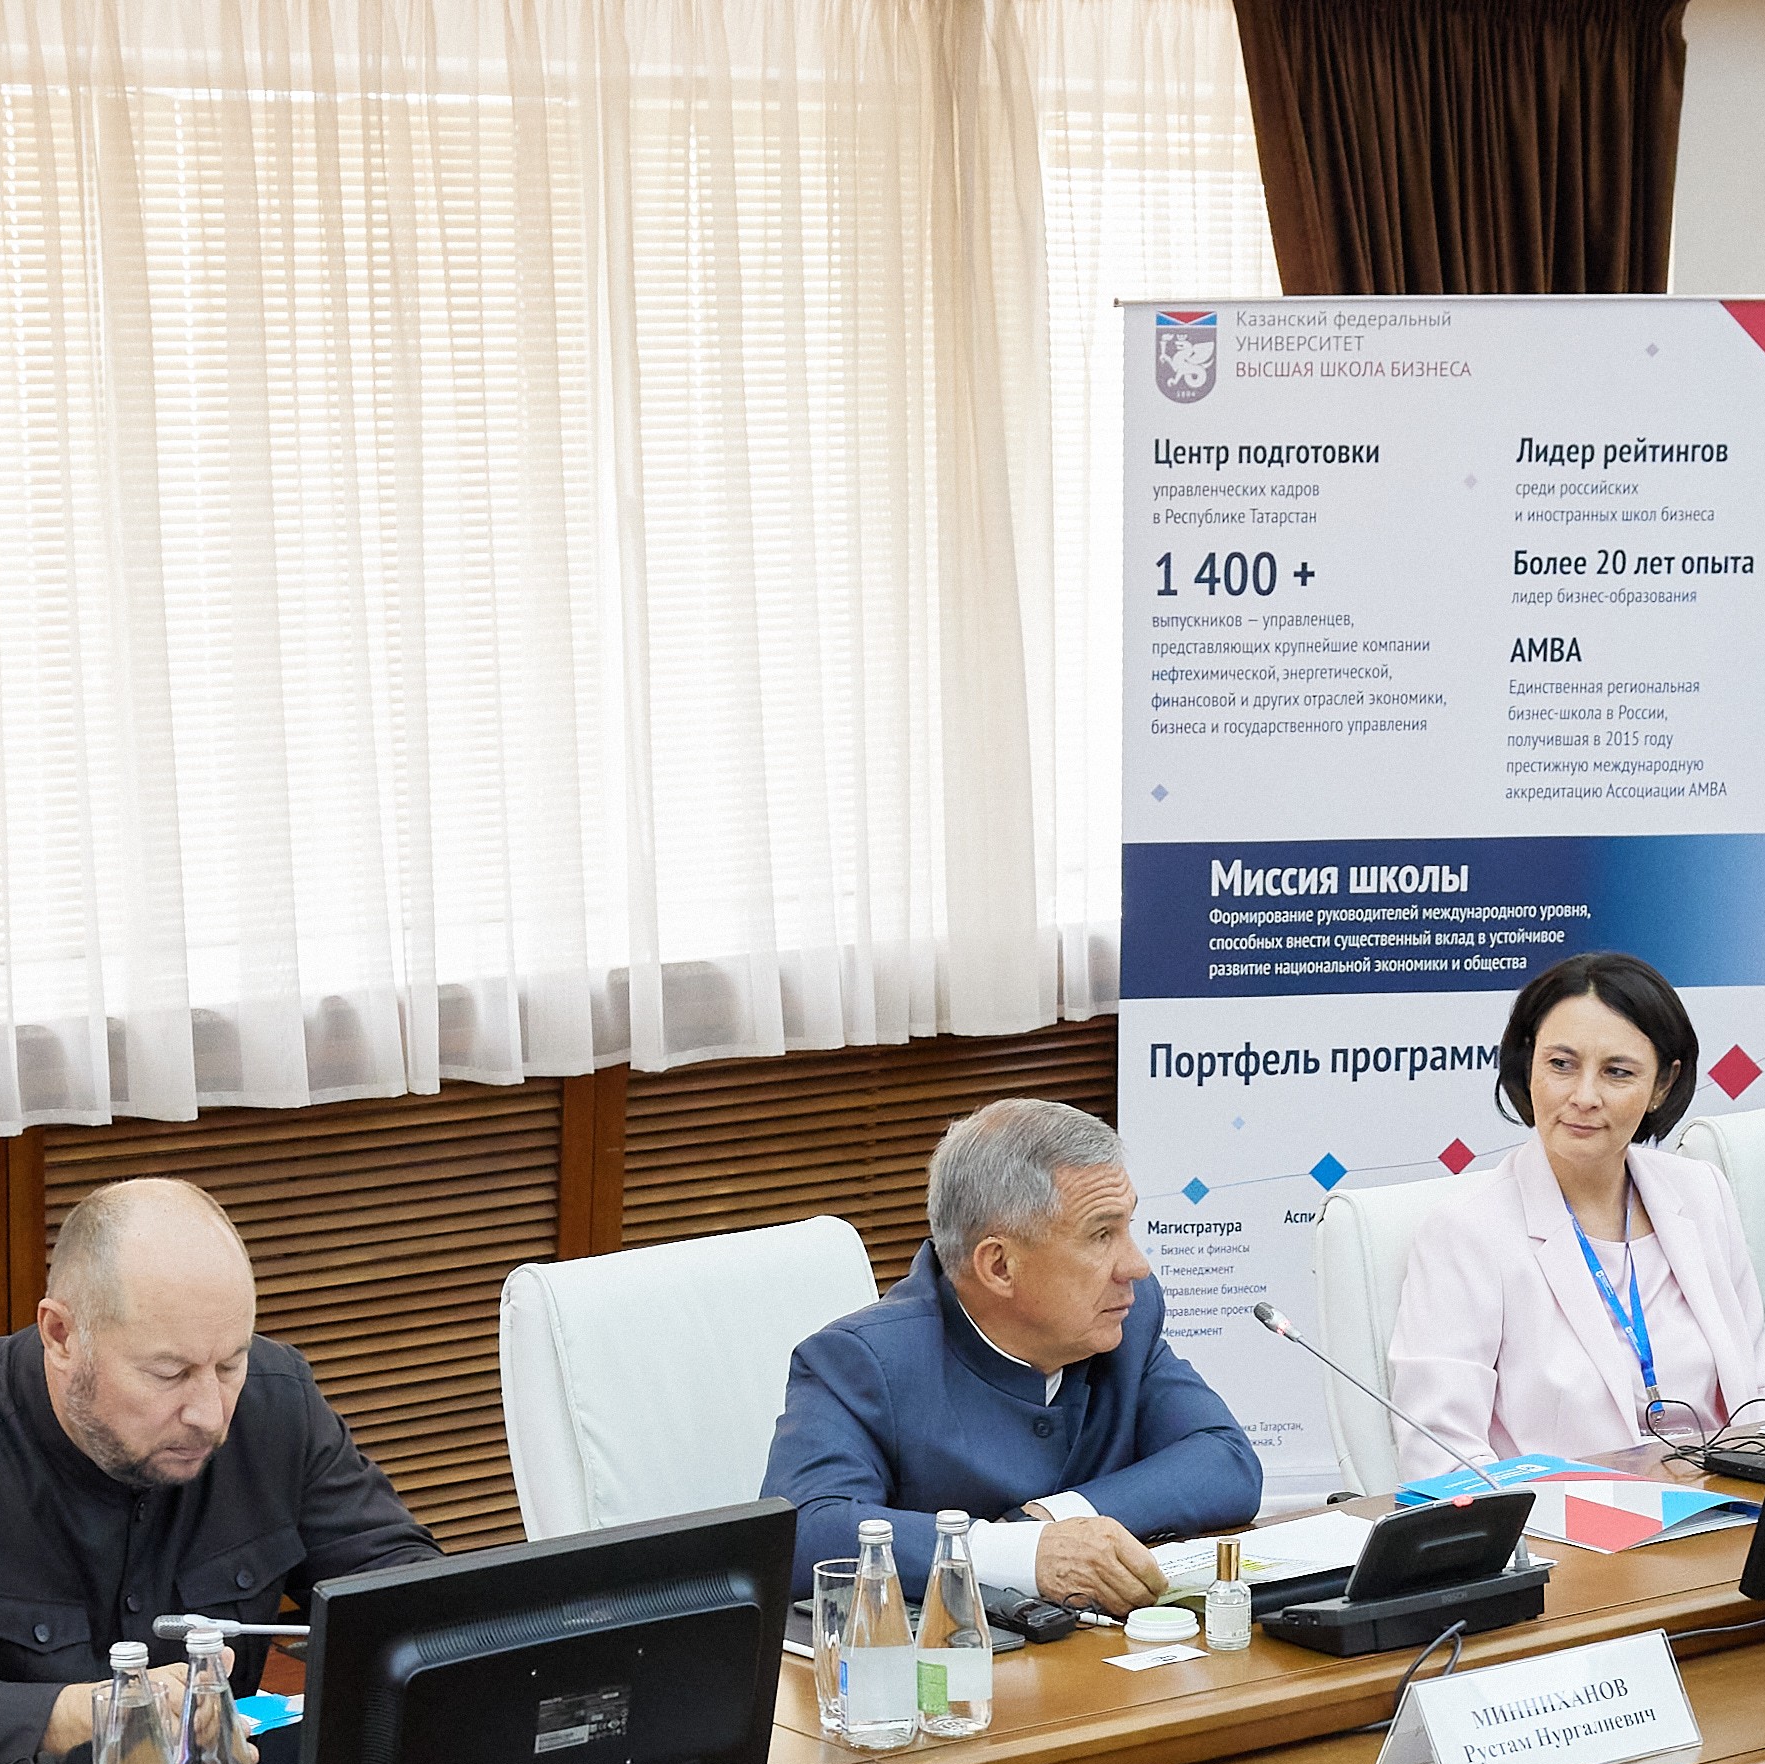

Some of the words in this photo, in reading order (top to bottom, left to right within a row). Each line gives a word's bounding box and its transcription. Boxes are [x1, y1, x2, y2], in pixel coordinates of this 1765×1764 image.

[1235, 310, 1327, 327] Казанский
[1332, 310, 1451, 330] федеральный
[1234, 334, 1364, 352] УНИВЕРСИТЕТ
[1235, 360, 1313, 378] ВЫСШАЯ
[1319, 360, 1386, 378] ШКОЛА
[1390, 360, 1472, 377] БИЗНЕСА
[1153, 437, 1230, 472] Центр
[1237, 443, 1379, 468] подготовки
[1515, 436, 1595, 470] Лидер
[1602, 436, 1728, 470] рейтингов
[1151, 483, 1266, 502] управленческих
[1269, 483, 1320, 500] кадров
[1514, 482, 1555, 499] среди
[1559, 479, 1639, 499] российских
[1164, 507, 1246, 528] Республике
[1248, 507, 1317, 528] Татарстан
[1526, 509, 1618, 526] иностранных
[1620, 509, 1657, 522] школ
[1660, 505, 1715, 522] бизнеса
[1513, 548, 1587, 576] Более
[1595, 548, 1627, 575] 20
[1632, 555, 1676, 575] лет
[1680, 554, 1754, 575] опыта
[1155, 551, 1178, 596] 1
[1193, 550, 1277, 596] 400
[1292, 561, 1315, 587] +
[1510, 590, 1553, 607] лидер
[1556, 586, 1697, 607] бизнес-образования
[1151, 614, 1243, 632] выпускников
[1261, 613, 1354, 631] управленцев,
[1151, 641, 1270, 658] представляющих
[1273, 637, 1358, 657] крупнейшие
[1361, 639, 1430, 652] компании
[1150, 664, 1280, 685] нефтехимической,
[1282, 663, 1392, 683] энергетической,
[1508, 678, 1603, 696] Единственная
[1606, 680, 1700, 697] региональная
[1507, 704, 1602, 721] бизнес-школа
[1617, 703, 1668, 721] России,
[1211, 858, 1338, 896] Миссия
[1349, 864, 1468, 893] школы
[1208, 907, 1314, 928] Формирование
[1316, 904, 1419, 926] руководителей
[1421, 904, 1537, 923] международного
[1538, 904, 1591, 921] уровня,
[1208, 932, 1283, 950] способных
[1285, 934, 1330, 949] внести
[1333, 929, 1431, 951] существенный
[1434, 932, 1475, 946] вклад
[1488, 927, 1565, 948] устойчивое
[1208, 962, 1271, 980] развитие
[1274, 956, 1371, 976] национальной
[1373, 958, 1448, 972] экономики
[1462, 953, 1527, 972] общества
[1149, 1040, 1320, 1087] Портфель
[1331, 1045, 1498, 1082] программ
[1146, 1219, 1242, 1237] Магистратура
[1471, 1678, 1628, 1729] МИННИХАНОВ
[1462, 1736, 1532, 1764] Рустам
[1534, 1707, 1657, 1749] Нургалиевич
